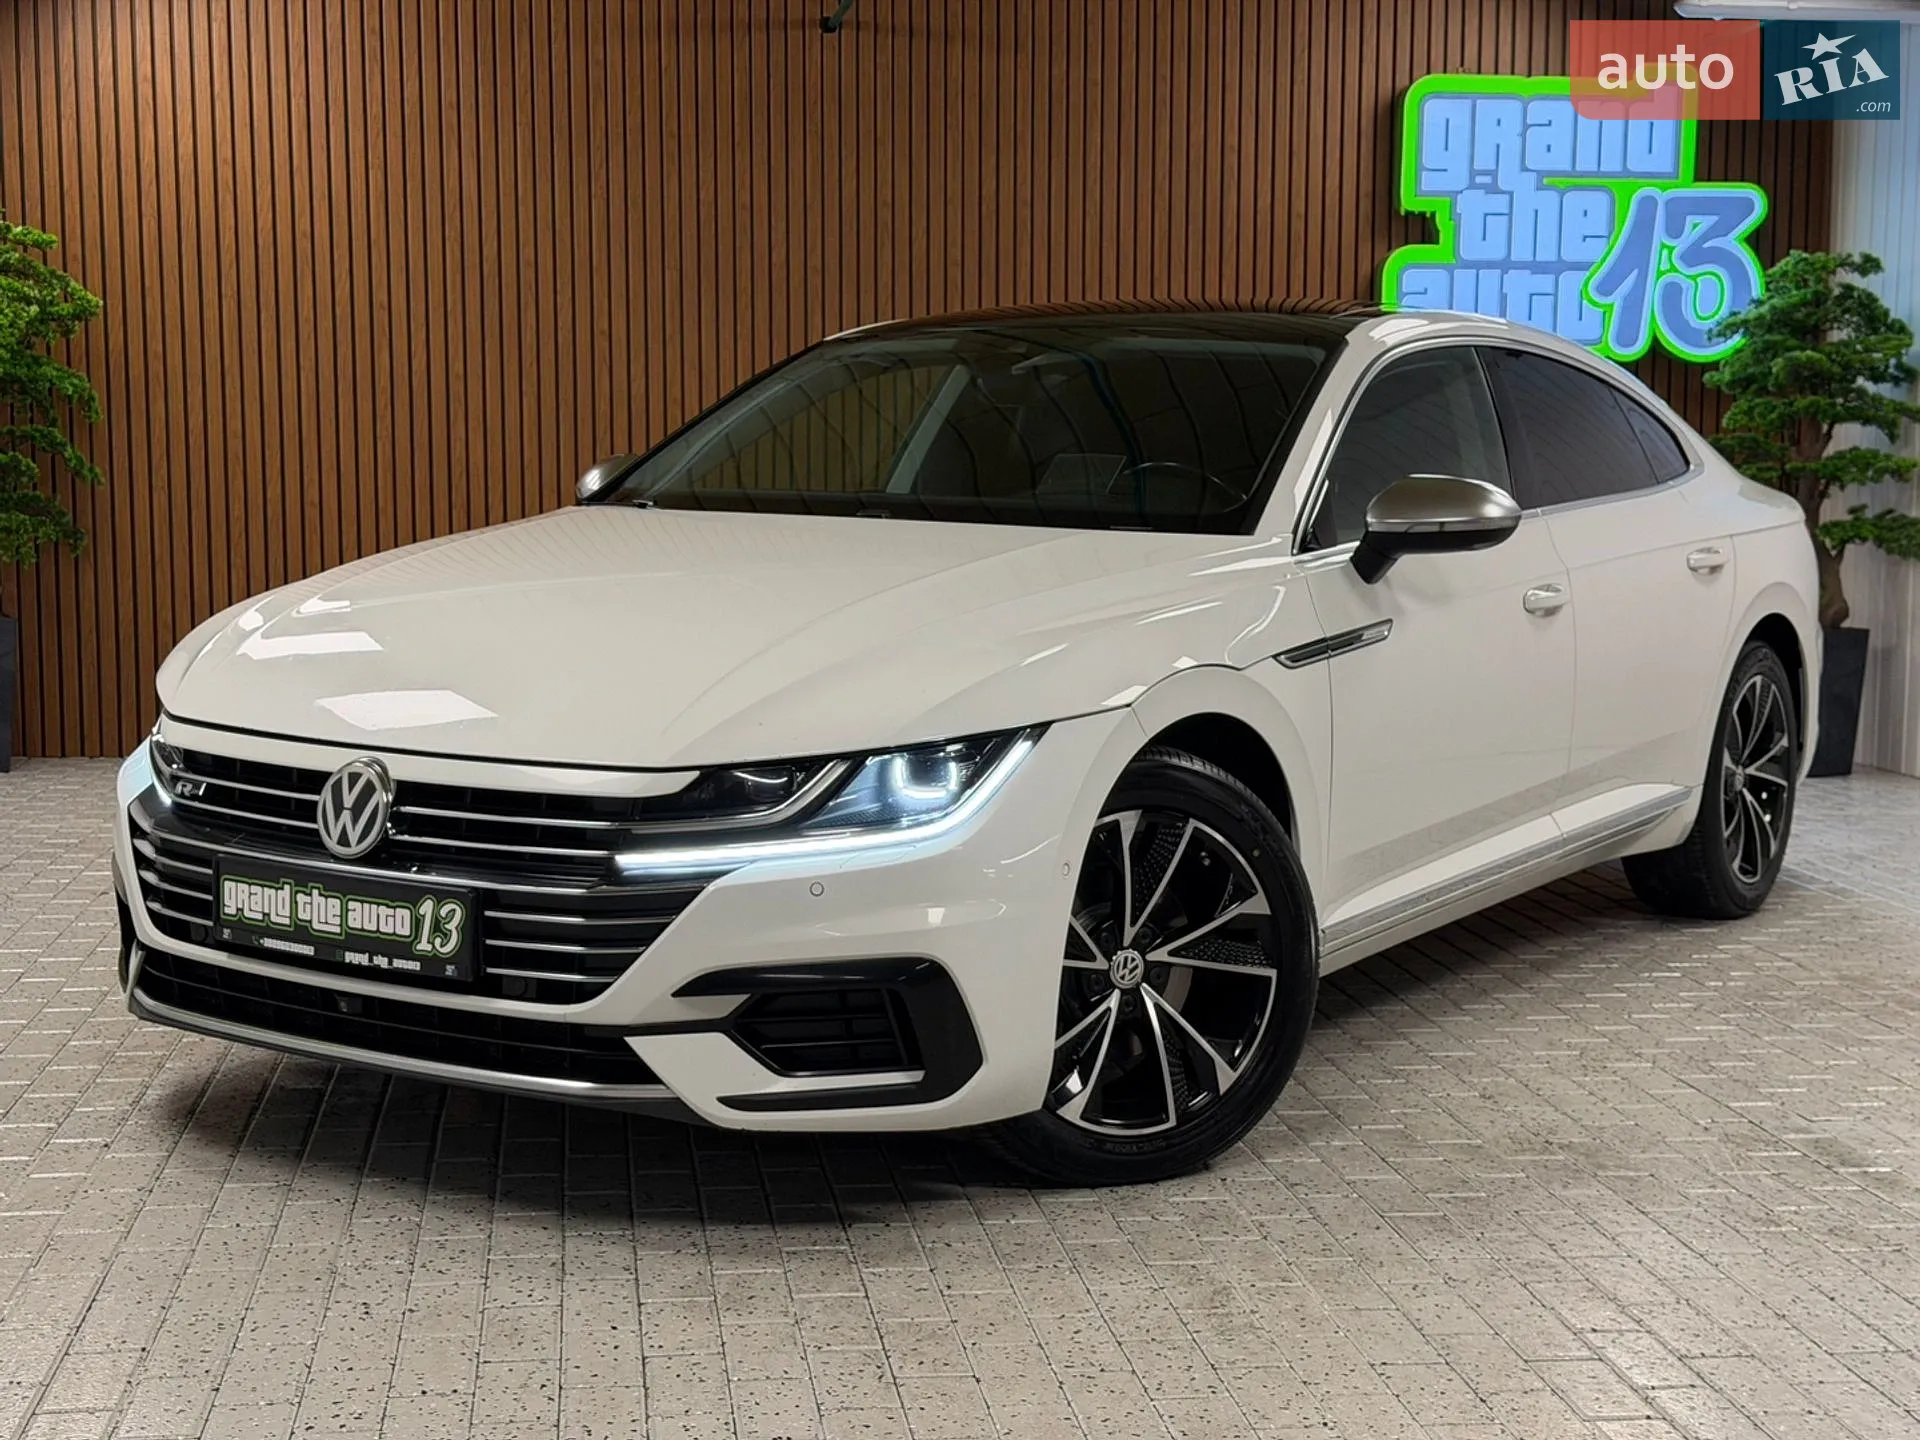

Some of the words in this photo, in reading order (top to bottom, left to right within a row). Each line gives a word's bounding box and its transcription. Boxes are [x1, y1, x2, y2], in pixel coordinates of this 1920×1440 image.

[1420, 82, 1680, 192] grand
[1455, 172, 1615, 263] the
[1590, 188, 1764, 357] 13
[222, 879, 292, 926] grand
[295, 887, 343, 934] the
[346, 900, 412, 938] auto
[414, 897, 464, 956] 13
